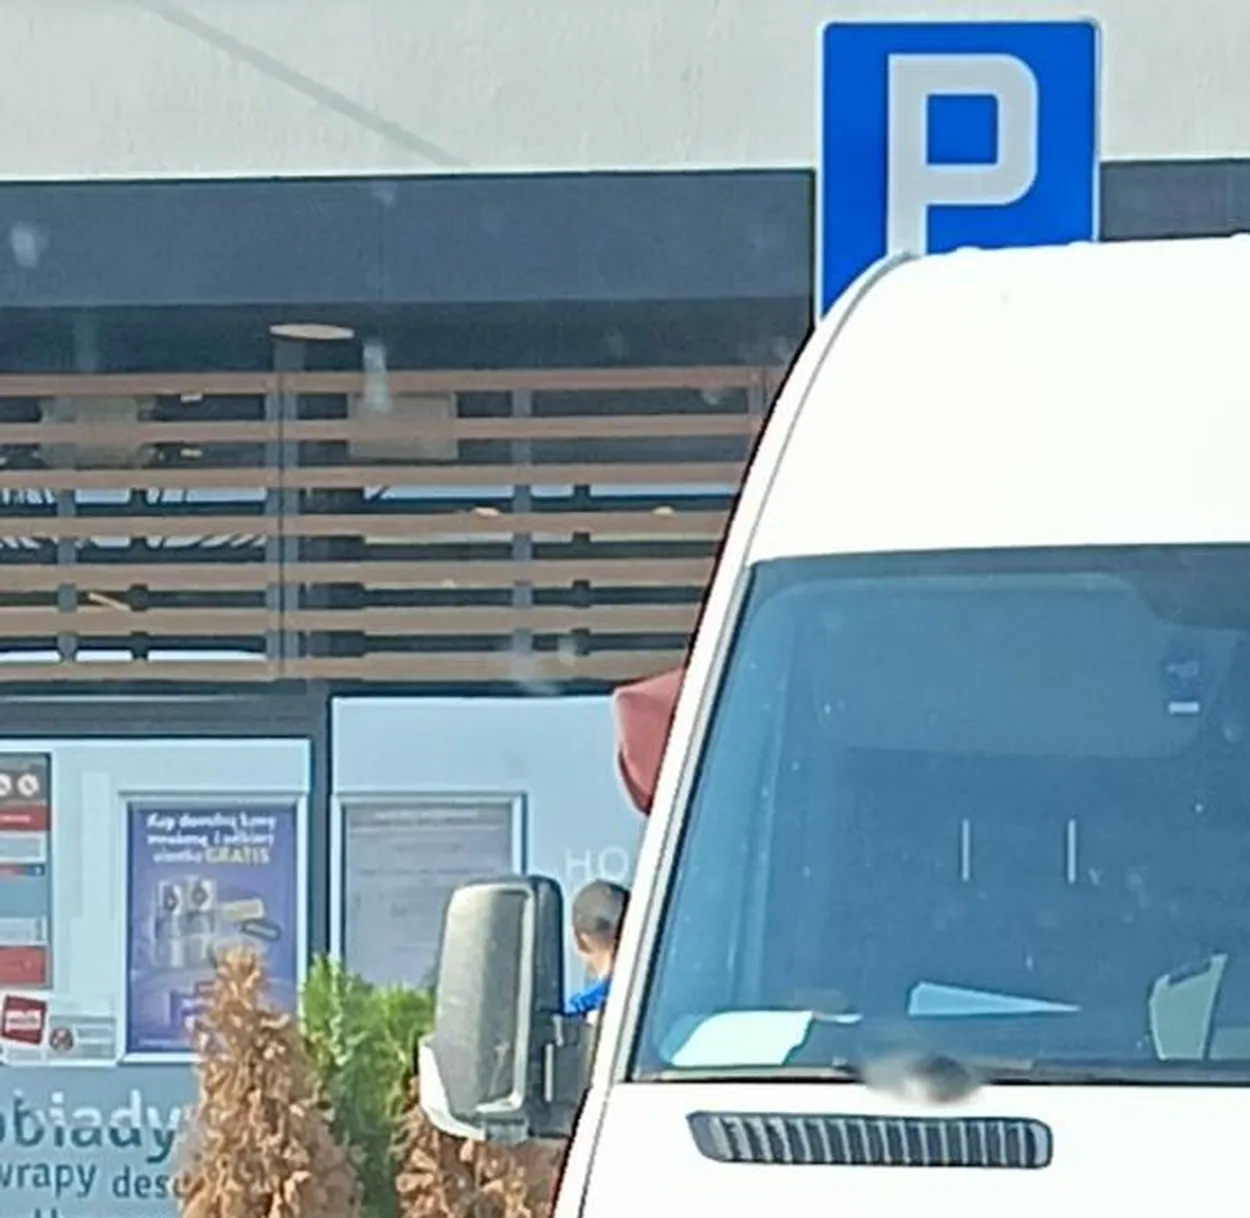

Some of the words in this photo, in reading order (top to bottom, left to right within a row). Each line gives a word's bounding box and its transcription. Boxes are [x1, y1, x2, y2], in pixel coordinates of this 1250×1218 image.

[887, 53, 1038, 256] P
[0, 1089, 181, 1164] biady
[112, 1165, 186, 1199] des
